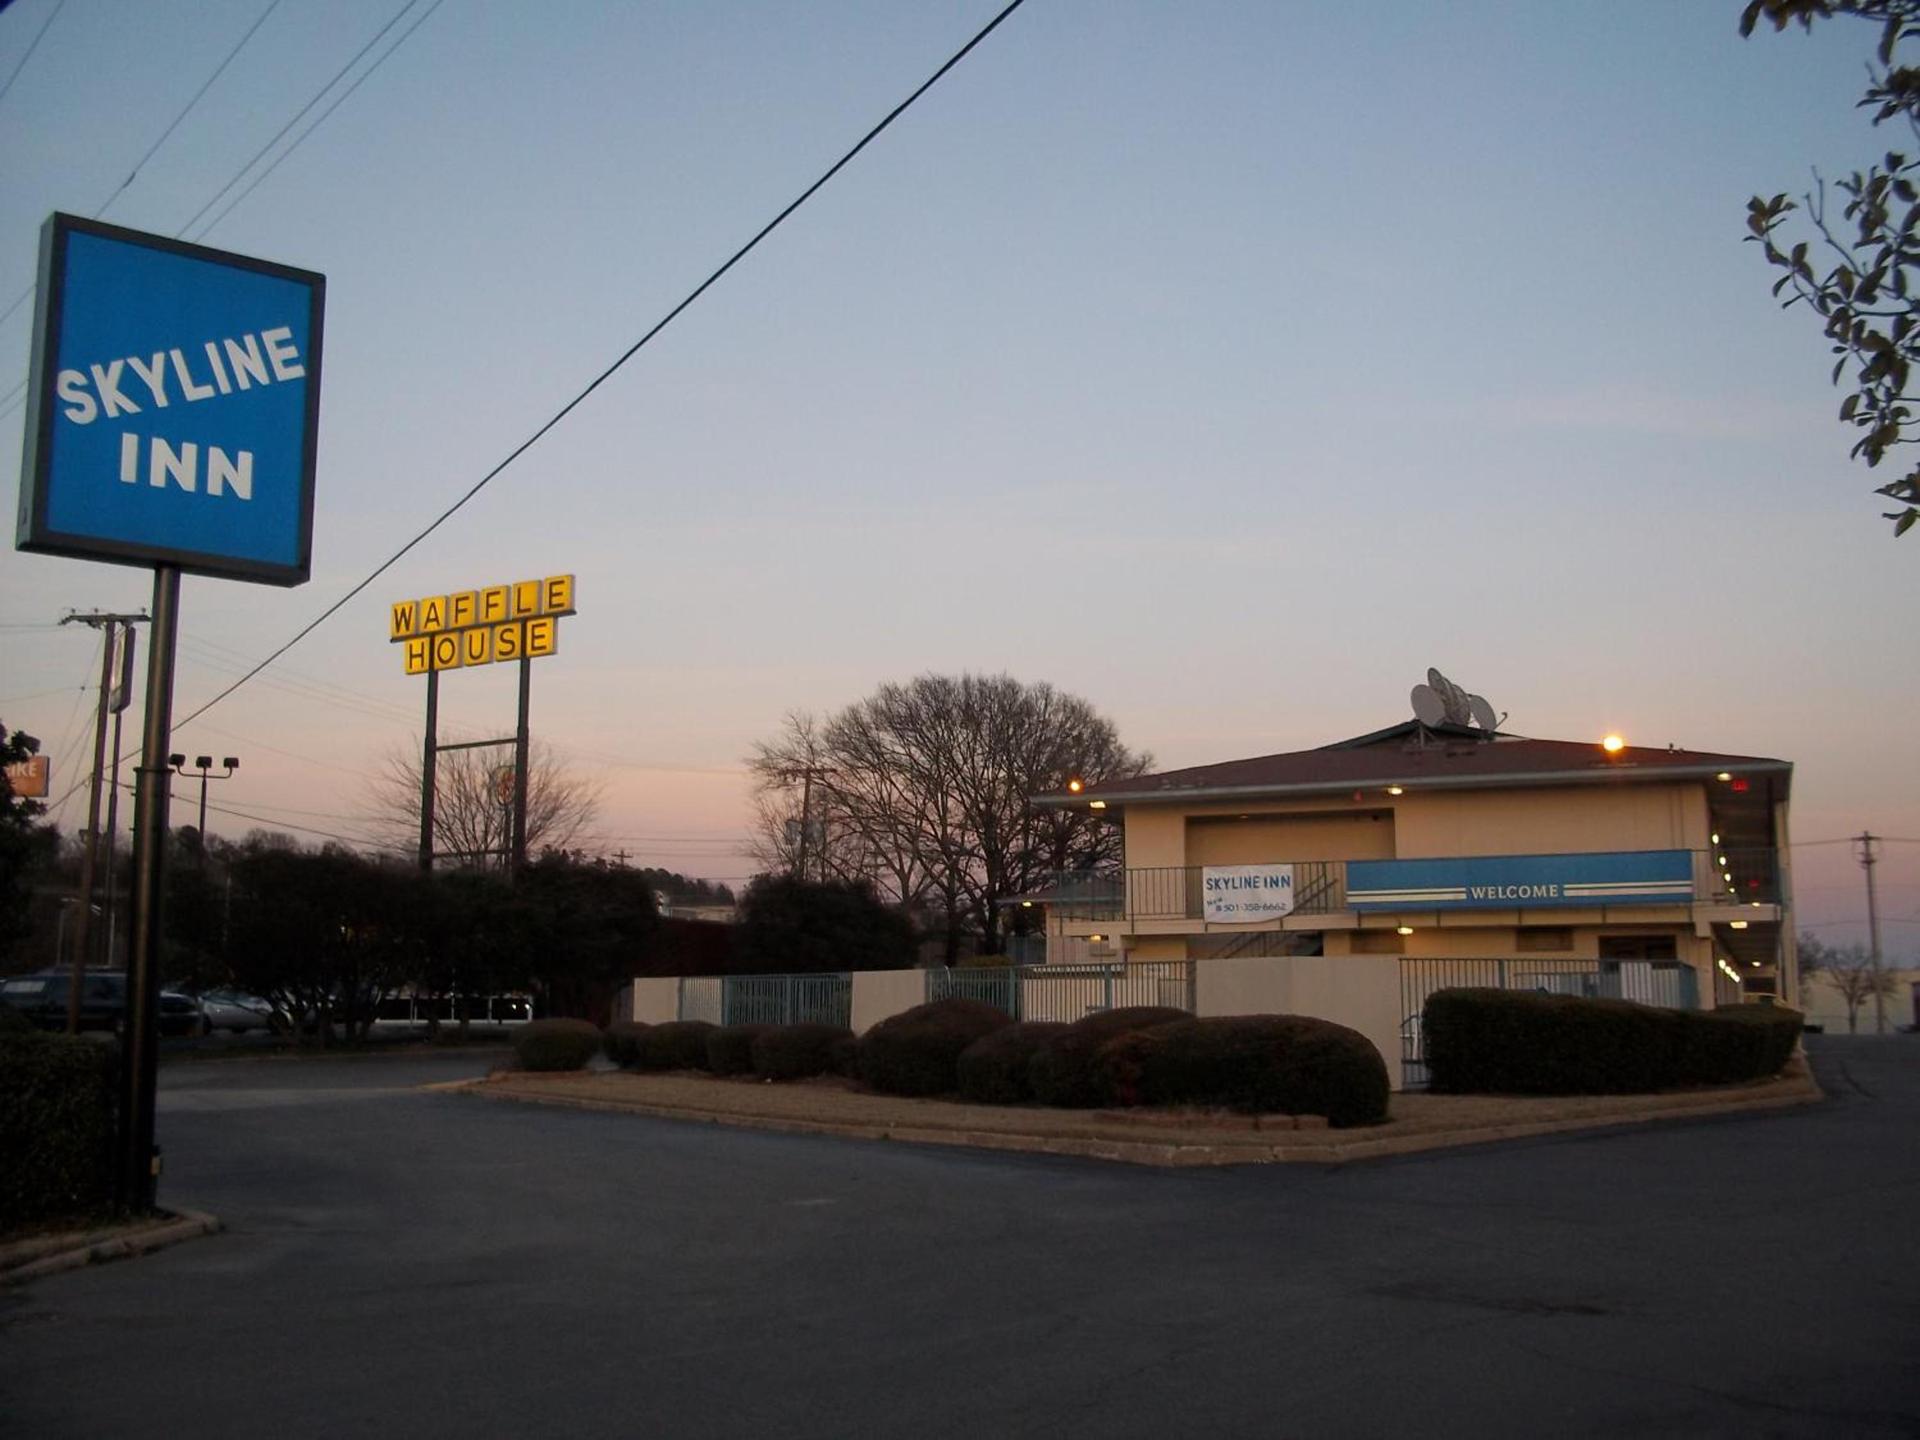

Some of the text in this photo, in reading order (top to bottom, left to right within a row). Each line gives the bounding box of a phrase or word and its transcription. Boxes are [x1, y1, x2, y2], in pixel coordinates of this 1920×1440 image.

[56, 325, 306, 426] SKYLINE
[120, 432, 253, 501] INN
[393, 579, 566, 634] WAFFLE
[409, 621, 548, 670] HOUSE
[1205, 874, 1291, 891] SKYLINE INN
[1470, 884, 1560, 900] WELCOME
